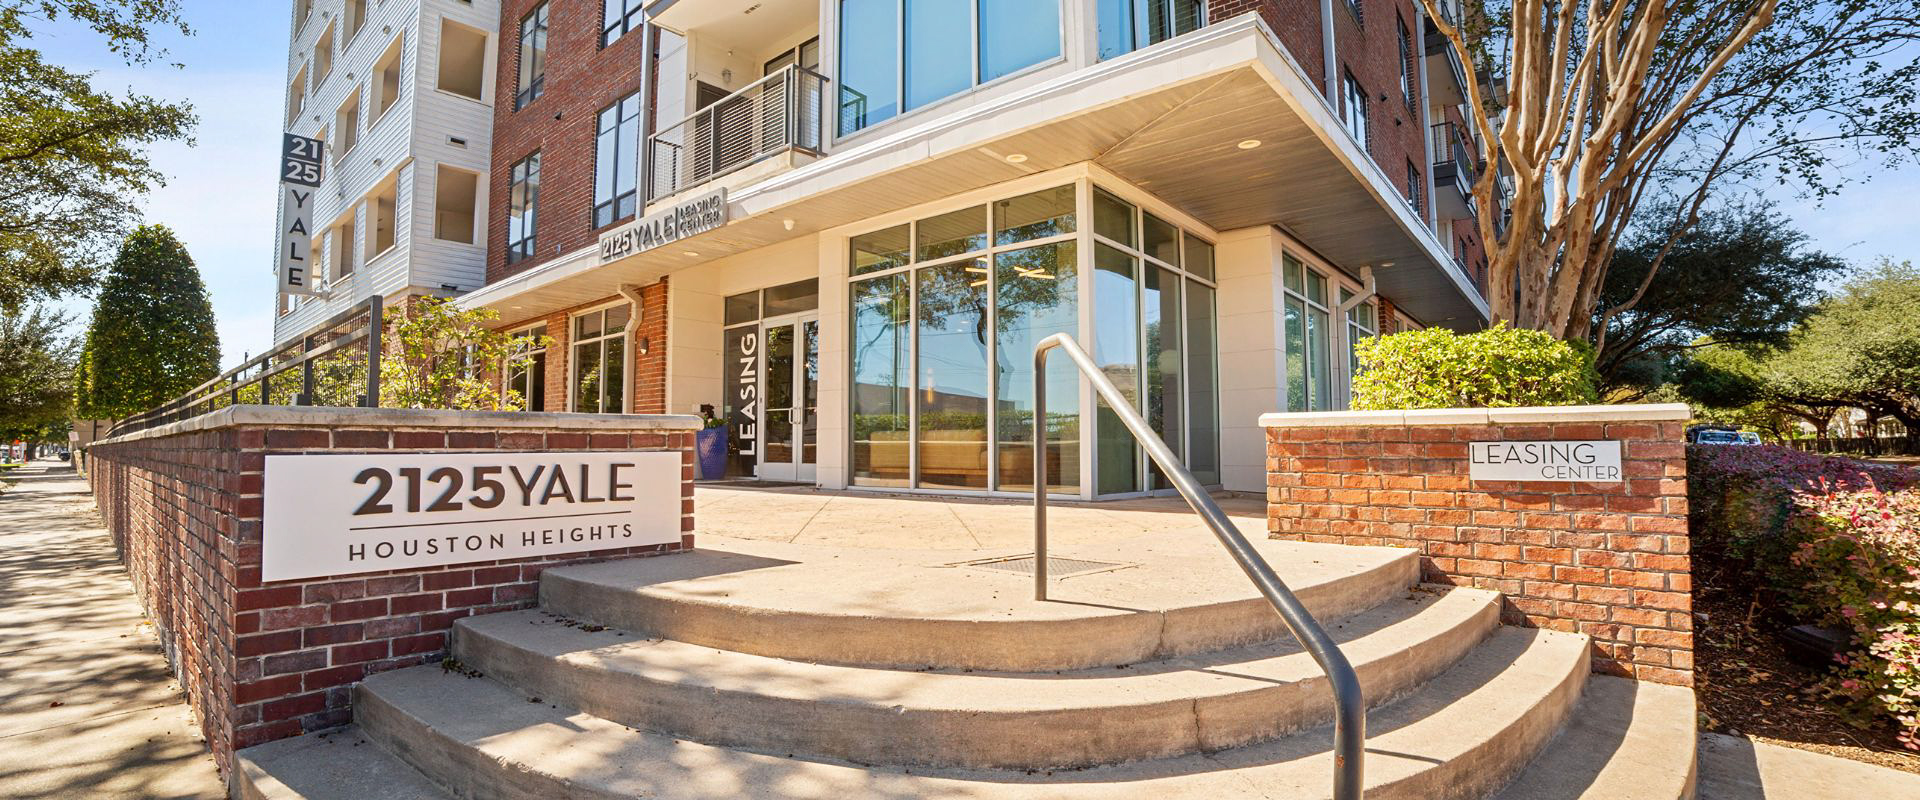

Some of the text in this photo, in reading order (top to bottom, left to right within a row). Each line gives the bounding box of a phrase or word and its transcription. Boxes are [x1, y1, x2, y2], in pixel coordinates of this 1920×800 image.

[290, 137, 318, 159] 21
[285, 161, 318, 183] 25
[680, 195, 720, 219] LEASING
[680, 211, 720, 233] CENTER
[288, 189, 310, 286] YALE
[739, 333, 757, 456] LEASING
[1472, 443, 1596, 464] LEASING
[1541, 465, 1619, 480] CENTER
[348, 523, 633, 561] HOUSTON HEIGHTS
